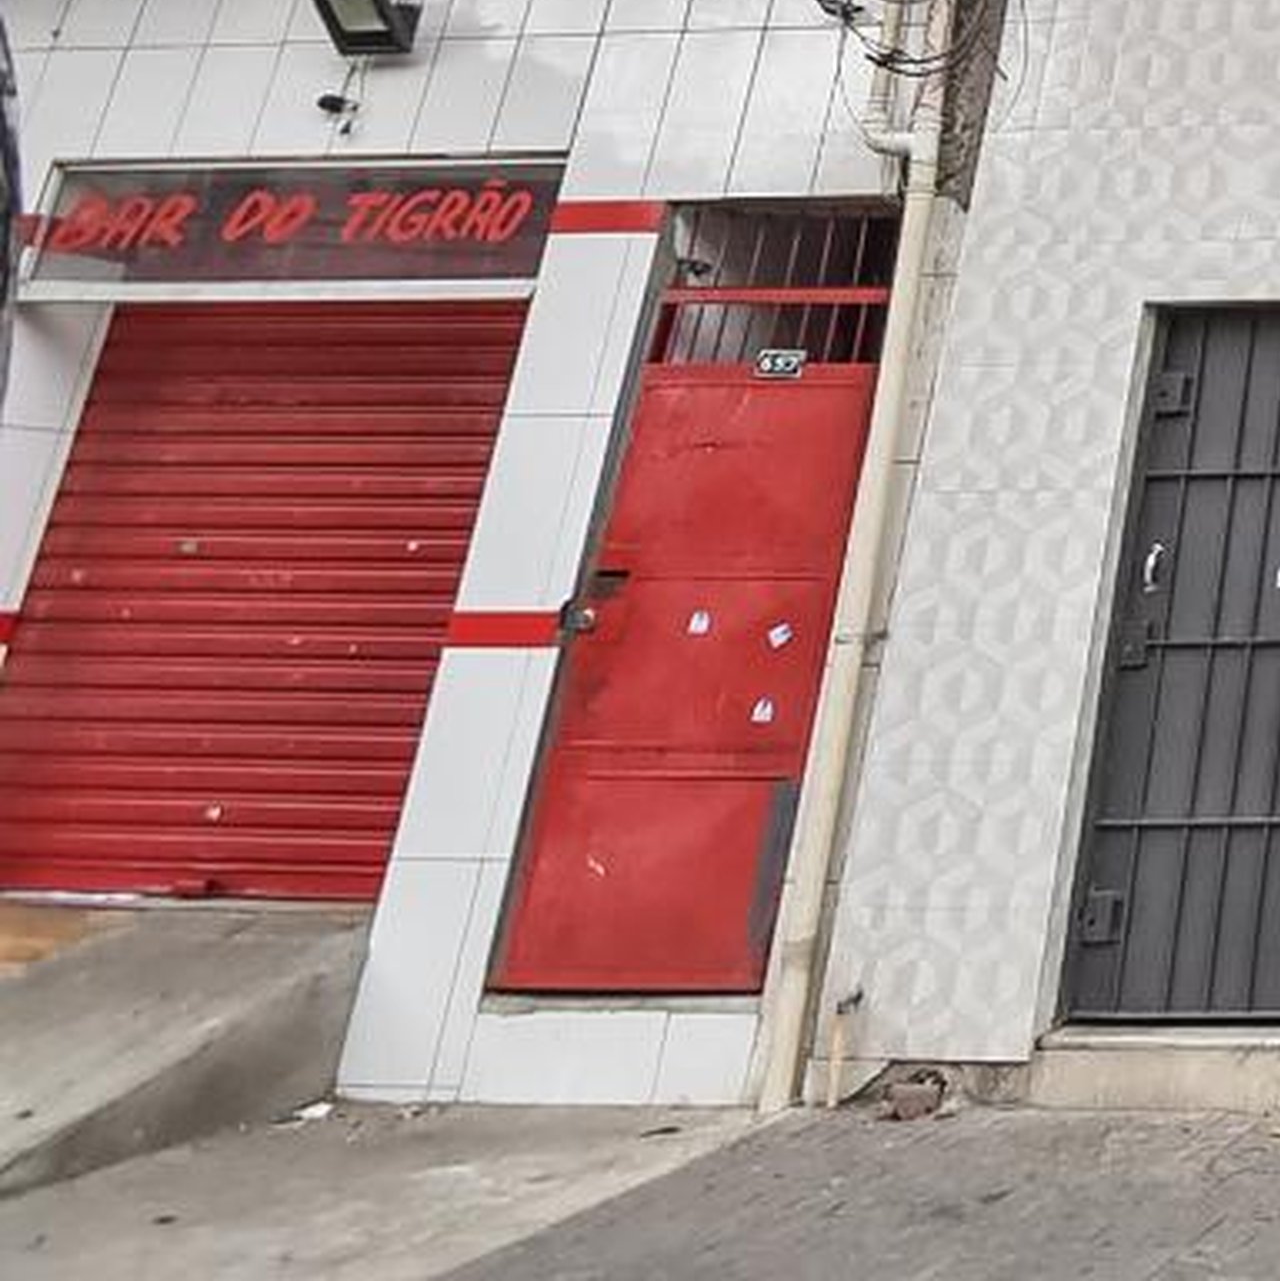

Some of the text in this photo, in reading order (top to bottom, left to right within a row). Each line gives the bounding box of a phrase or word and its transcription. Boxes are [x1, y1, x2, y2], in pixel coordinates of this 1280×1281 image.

[53, 179, 533, 250] BAR DO TIGRÃO
